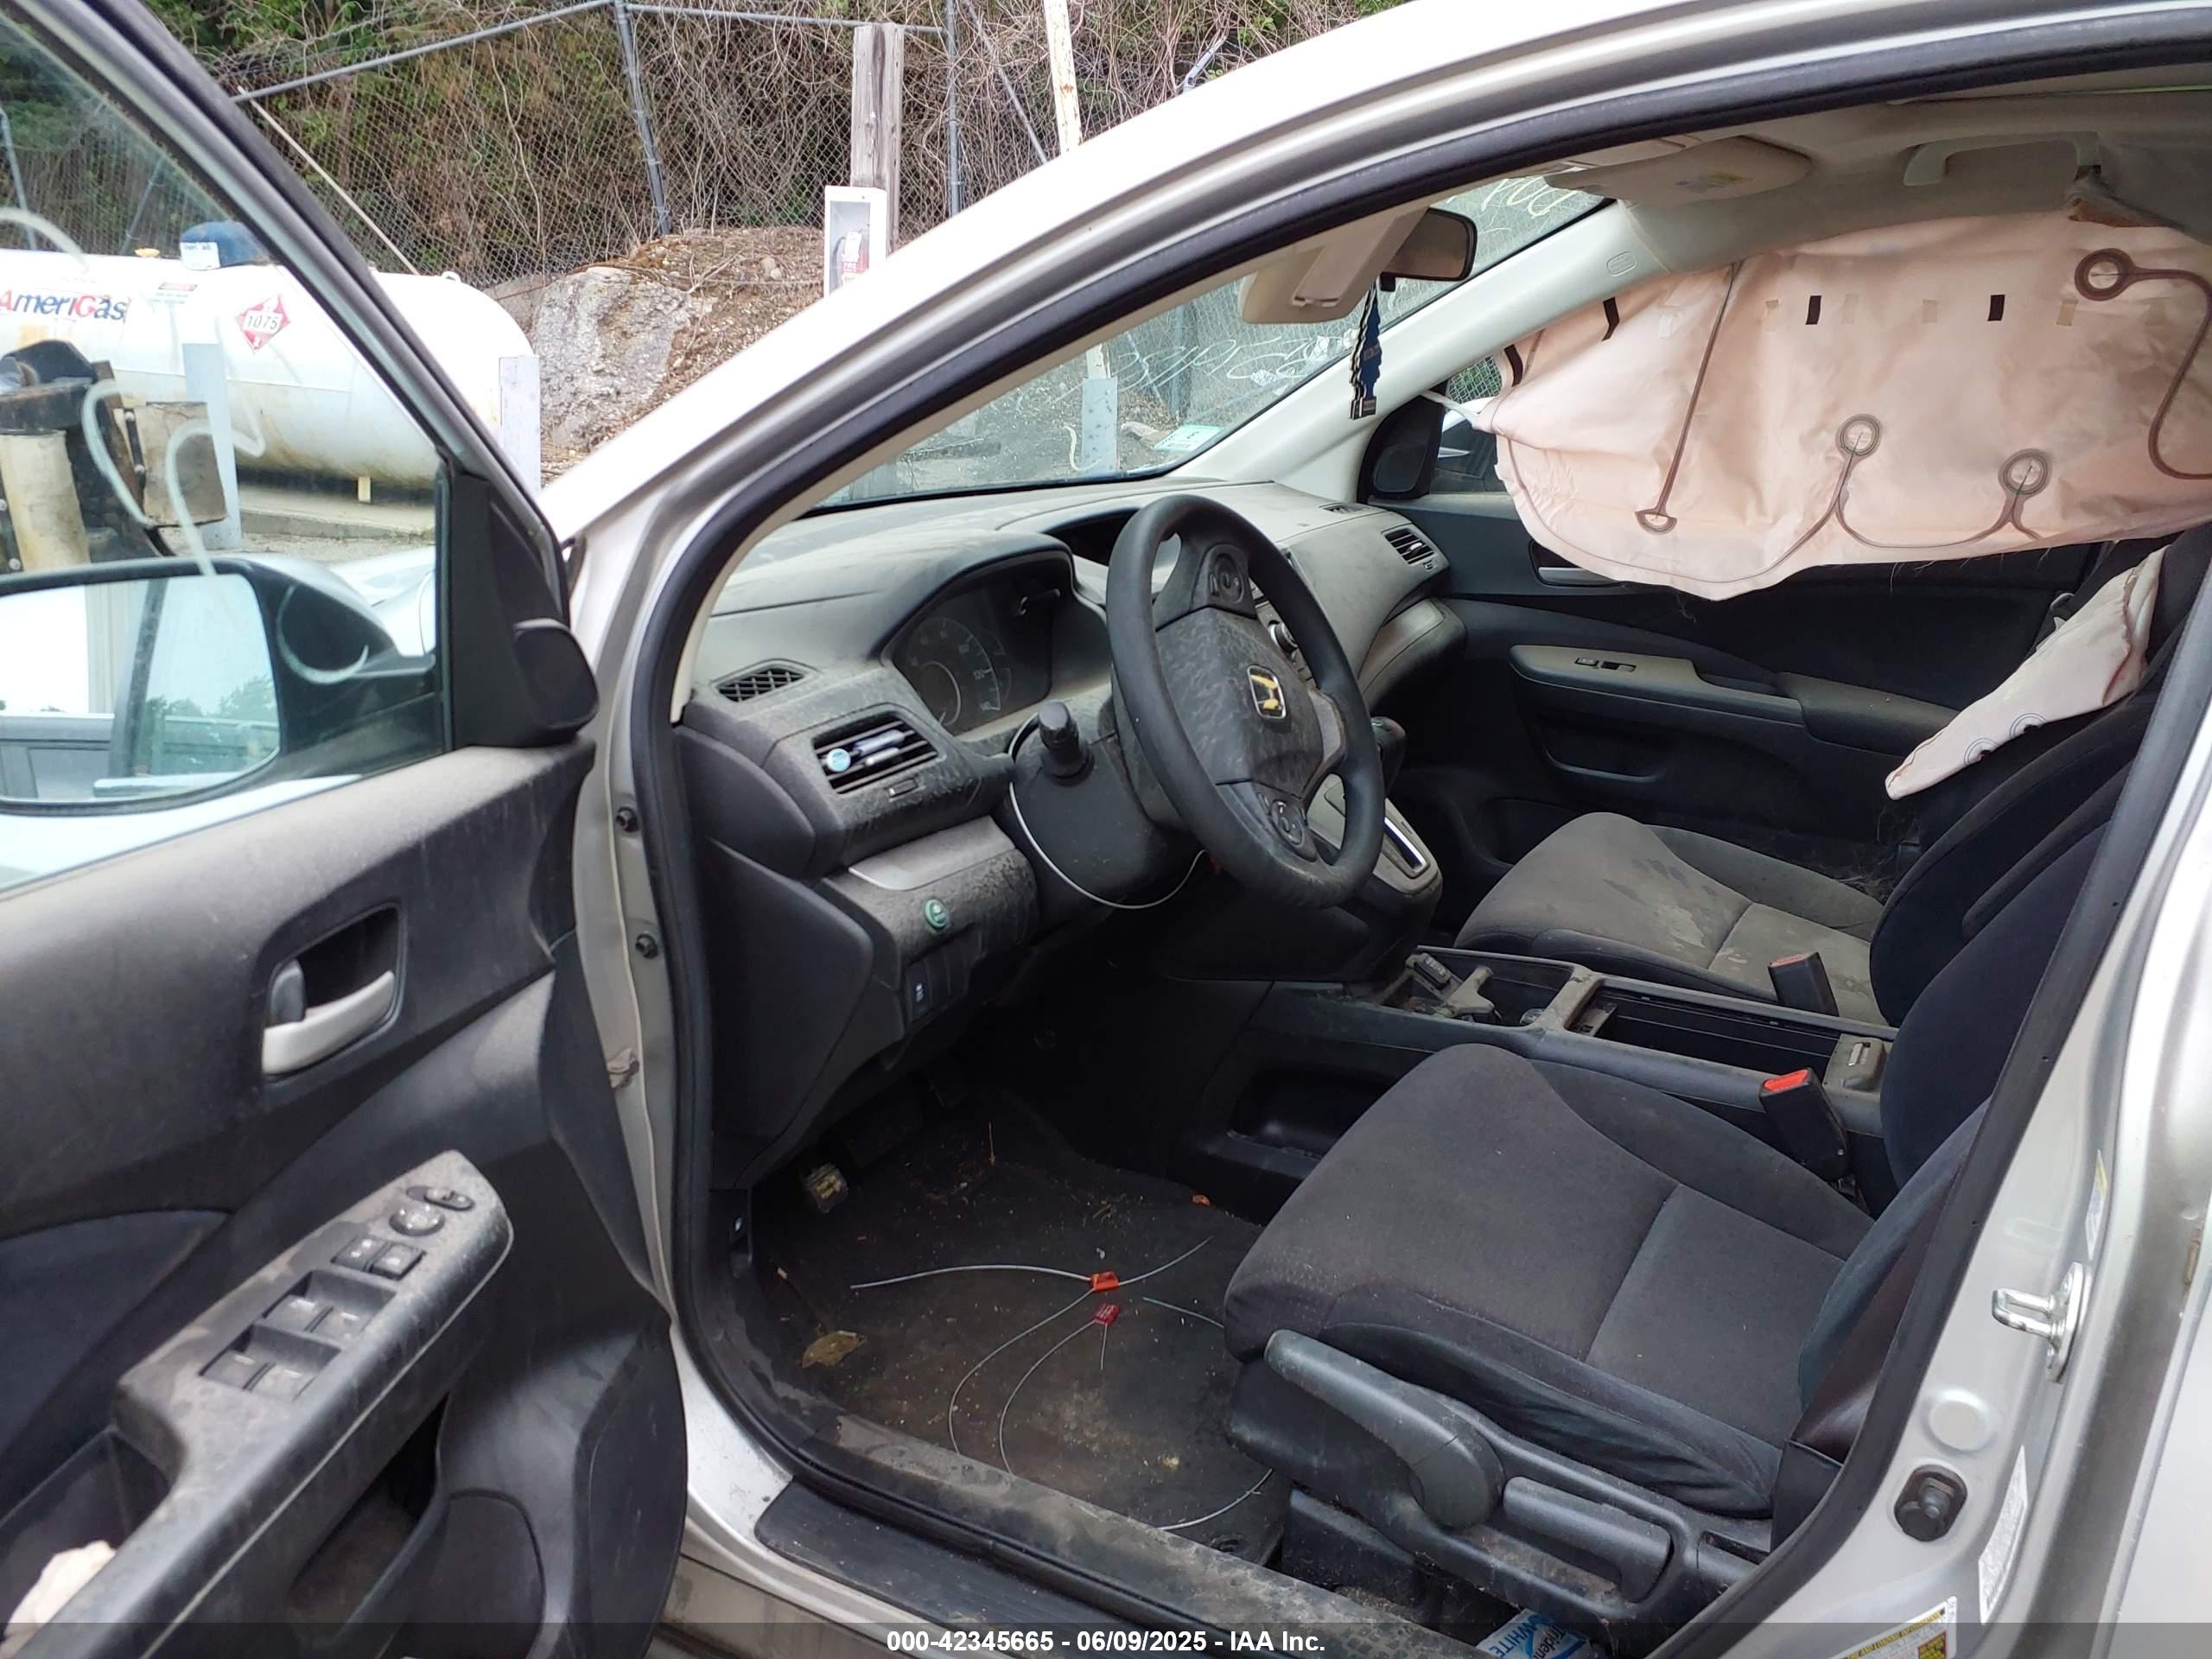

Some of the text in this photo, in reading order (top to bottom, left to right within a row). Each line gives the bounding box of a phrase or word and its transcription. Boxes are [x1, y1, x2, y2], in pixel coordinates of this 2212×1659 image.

[0, 289, 126, 321] AmeriGas
[248, 315, 279, 330] 1075
[1489, 1621, 1538, 1658] WHITE
